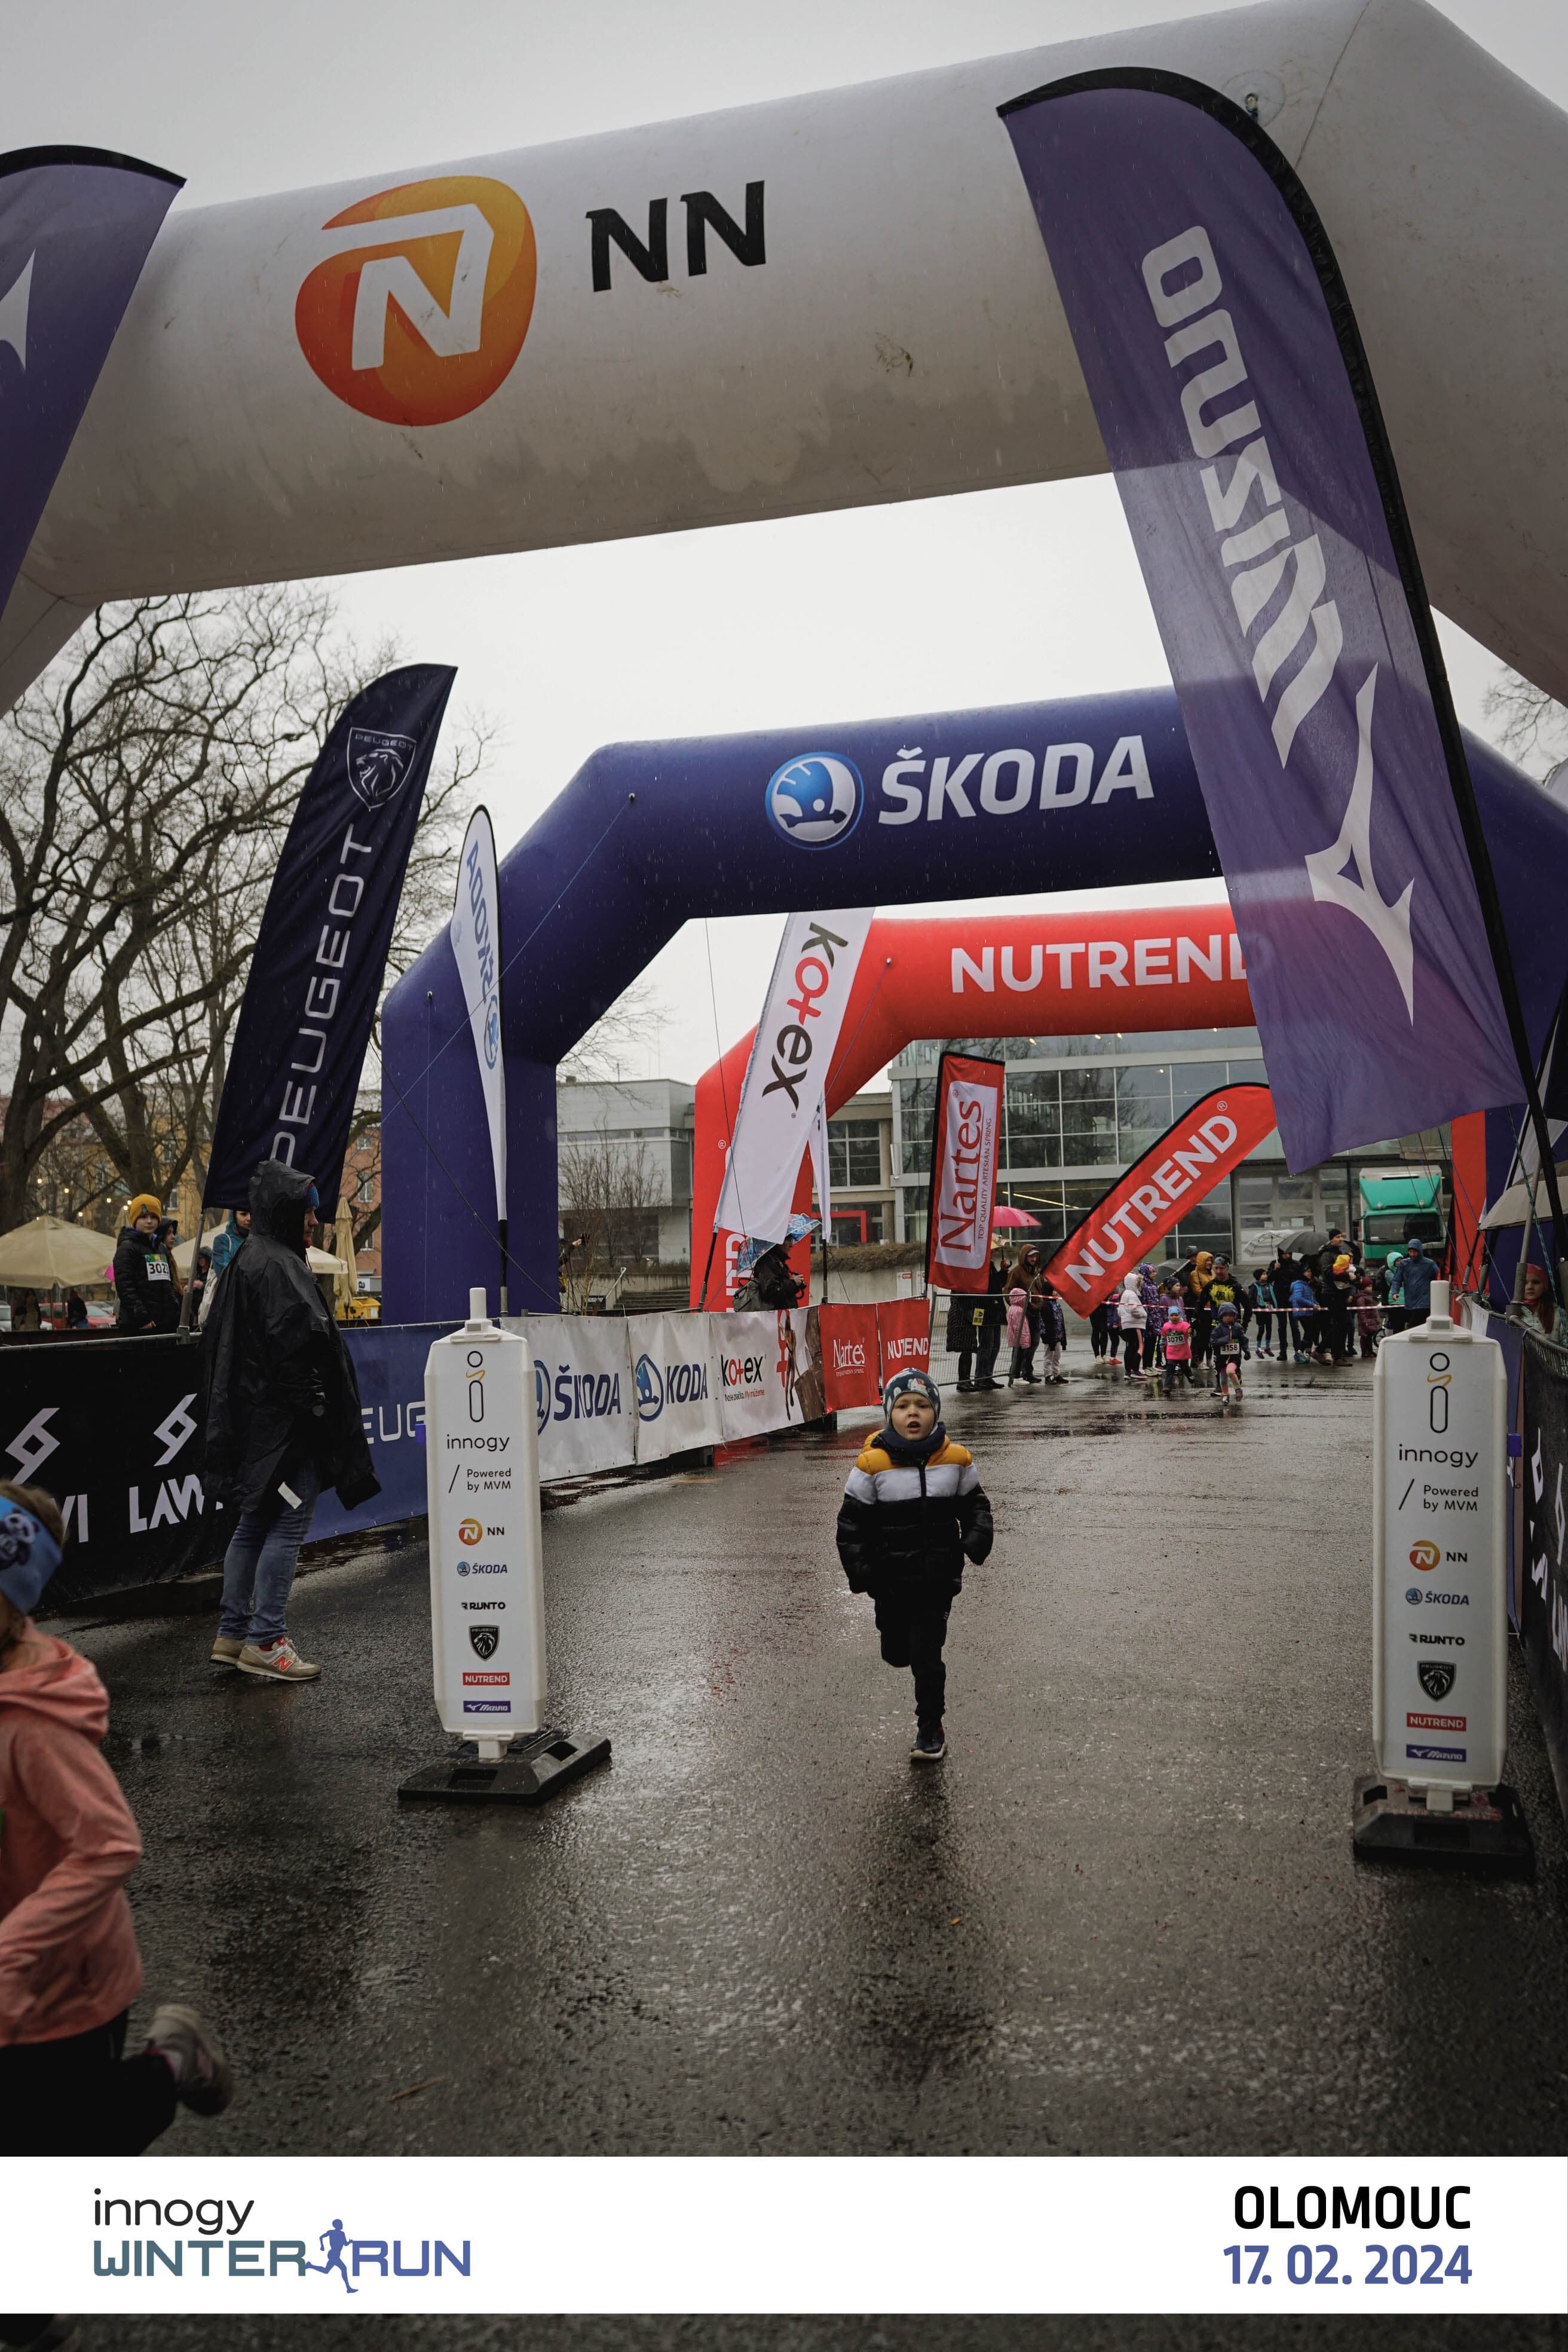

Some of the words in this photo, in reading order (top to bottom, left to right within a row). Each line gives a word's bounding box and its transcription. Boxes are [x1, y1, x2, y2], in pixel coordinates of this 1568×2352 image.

[585, 180, 766, 292] NN
[355, 733, 414, 751] PEUGEOT
[878, 735, 1154, 826] ŠKODA
[951, 933, 1249, 994] NUTREN
[269, 823, 372, 1168] PEUGEOT
[940, 1100, 982, 1253] Nartes
[982, 1149, 991, 1186] ARTESIAN
[1064, 1114, 1238, 1293] NUTREND
[833, 1339, 865, 1368] Nartes
[664, 1362, 708, 1405] KODA
[553, 1364, 621, 1422] ŠKODA
[447, 1434, 510, 1452] innogy
[1399, 1444, 1478, 1468] innogy
[467, 1468, 512, 1478] Powered
[467, 1482, 479, 1493] by
[484, 1481, 512, 1490] MVM
[1423, 1485, 1479, 1497] Powered
[1423, 1499, 1438, 1512] by
[1444, 1500, 1478, 1511] MVM
[487, 1527, 505, 1536] NN
[1446, 1552, 1468, 1563] NN
[472, 1563, 508, 1574] ŠKODA
[1425, 1591, 1469, 1605] ŠKODA
[465, 1674, 508, 1683] NUTREND
[1410, 1716, 1463, 1728] NUTREND
